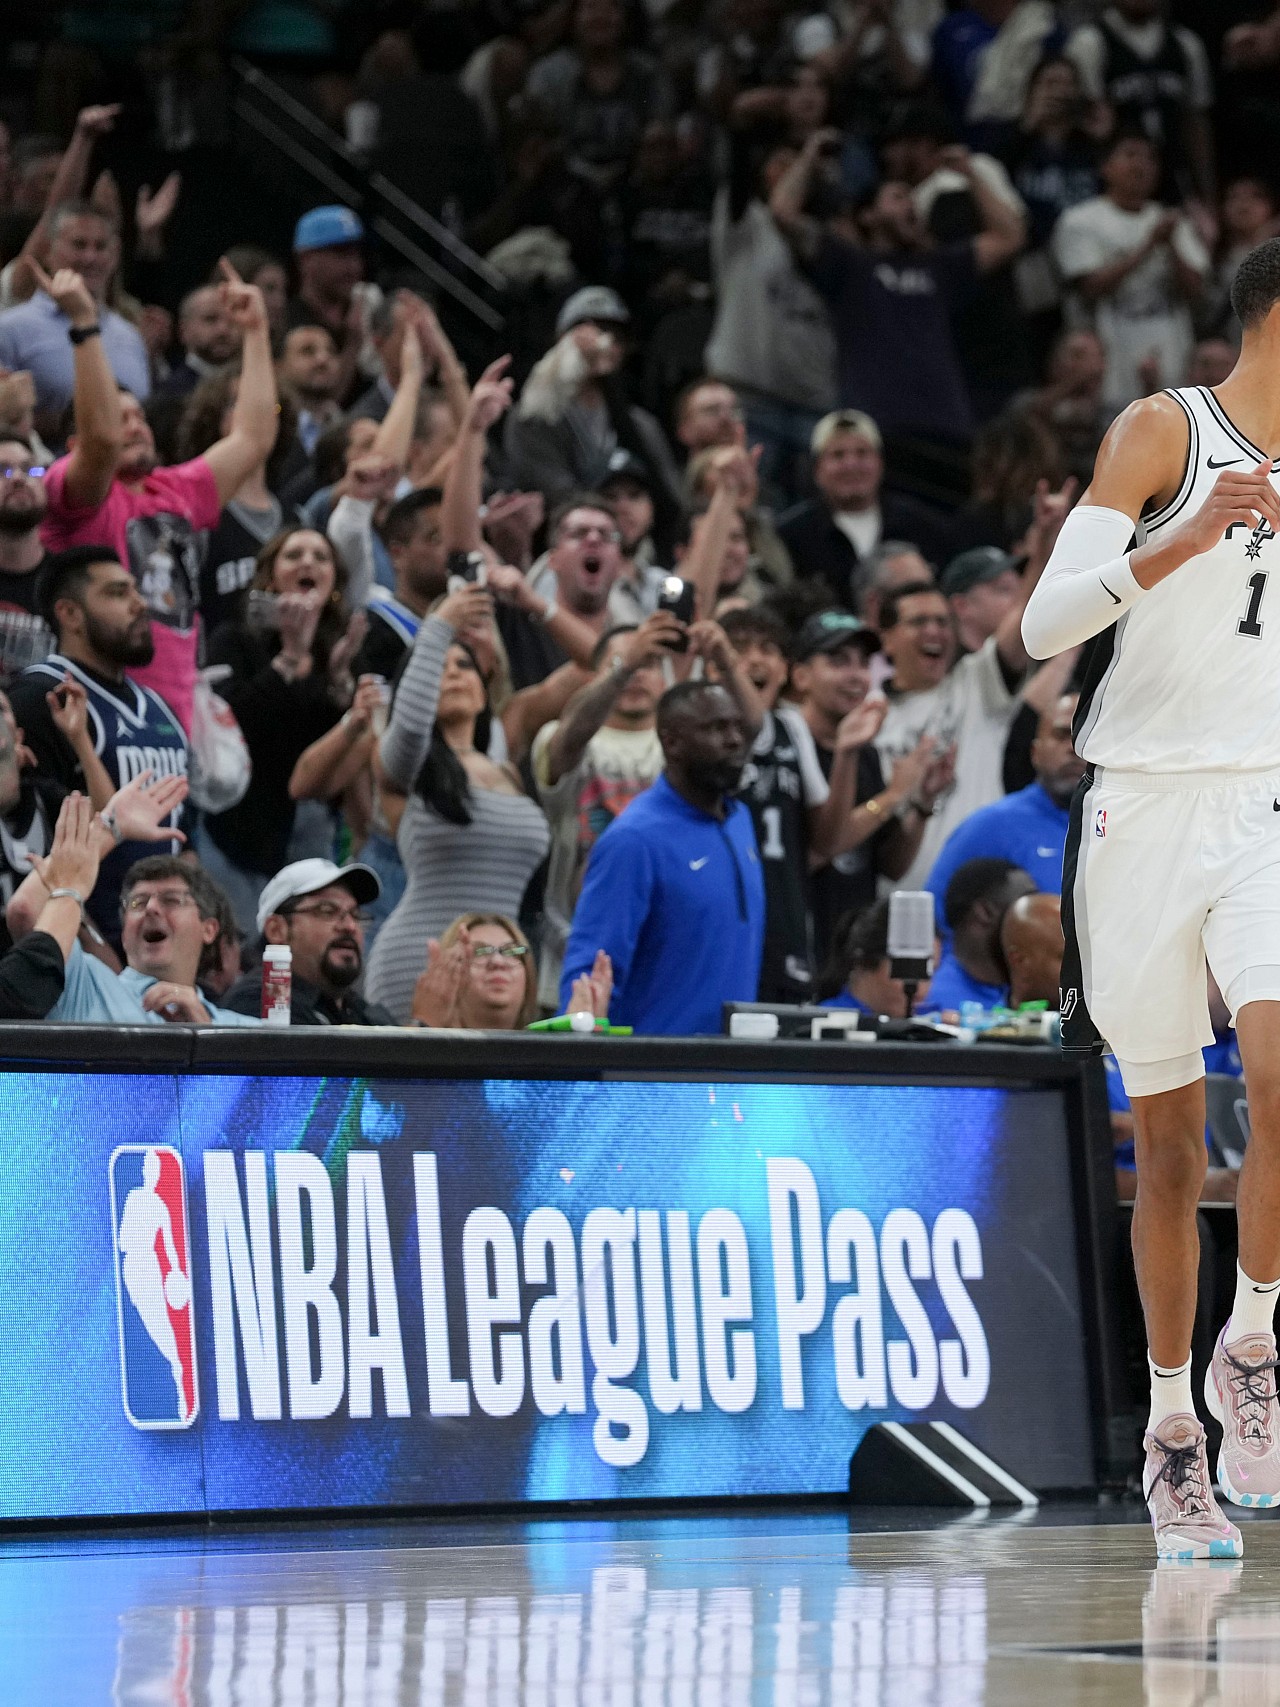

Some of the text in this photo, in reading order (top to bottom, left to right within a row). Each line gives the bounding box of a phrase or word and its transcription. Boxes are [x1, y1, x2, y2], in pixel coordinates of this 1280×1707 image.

[1235, 569, 1270, 640] 1
[762, 806, 786, 860] 1
[204, 1150, 991, 1467] NBA League Pass
